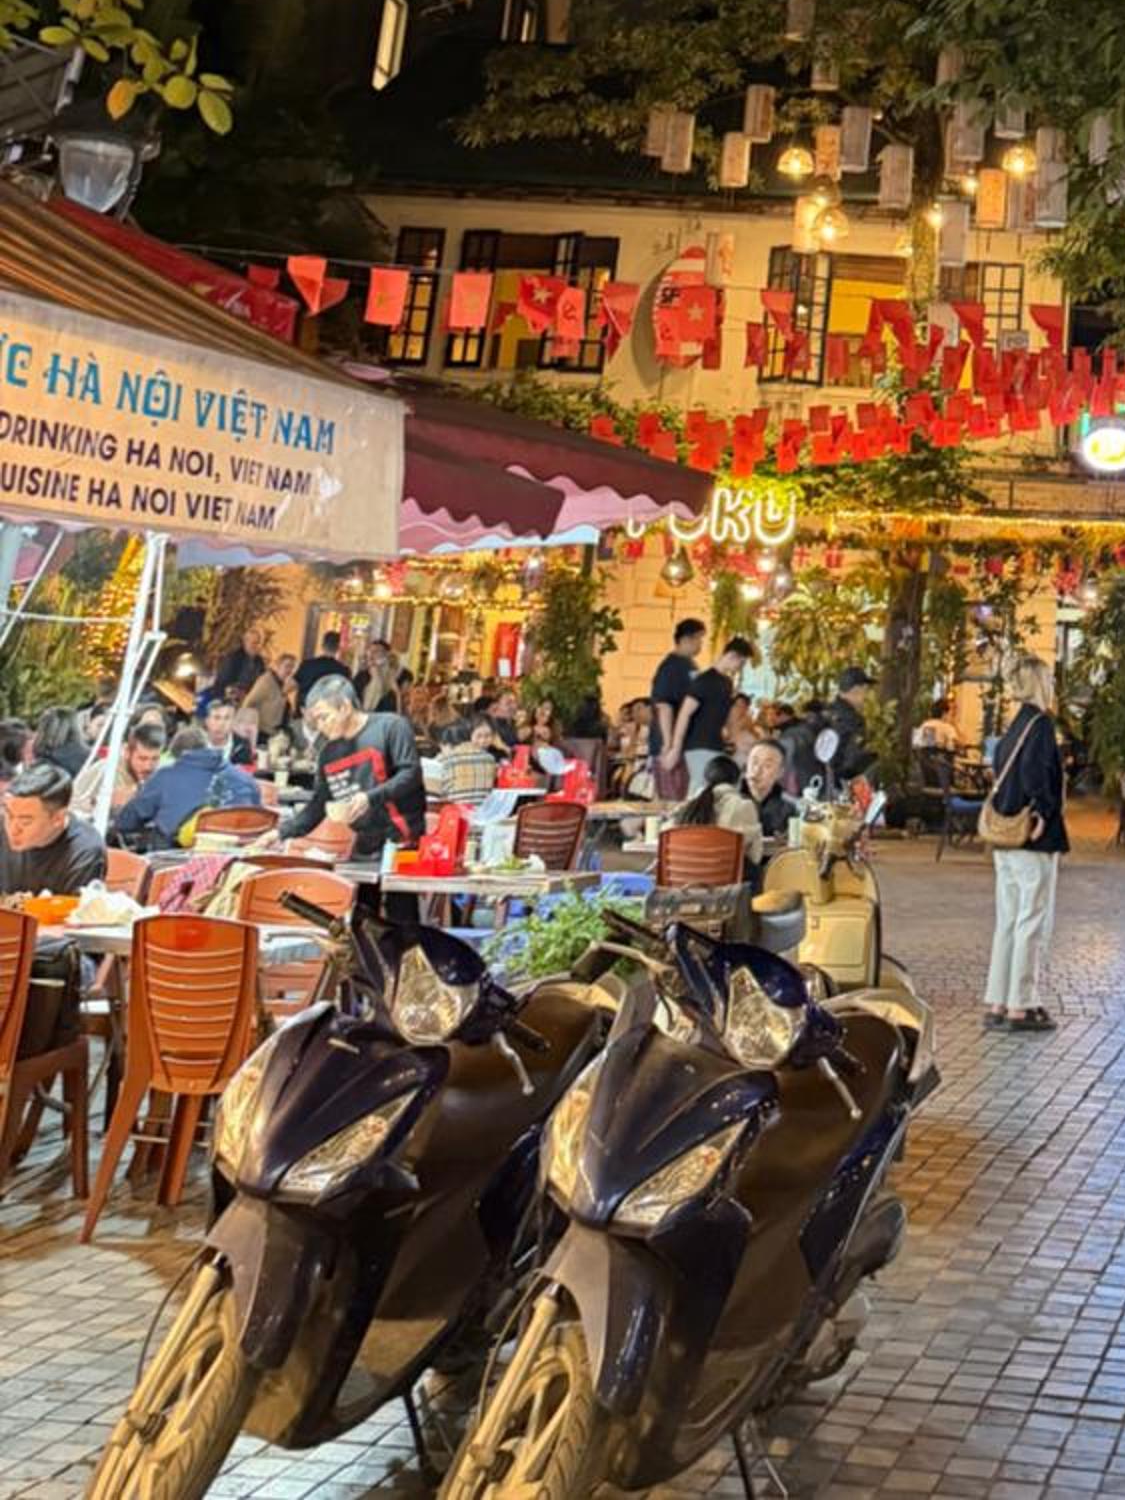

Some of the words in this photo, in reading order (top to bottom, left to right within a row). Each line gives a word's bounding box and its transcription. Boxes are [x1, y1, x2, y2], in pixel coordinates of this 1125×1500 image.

[43, 352, 102, 405] HÀ
[117, 369, 182, 427] NỘI
[195, 388, 268, 442] VIỆT
[273, 409, 336, 455] NAM
[126, 438, 162, 470] HA
[169, 450, 221, 484] NOI,
[230, 455, 264, 483] VIET
[265, 466, 312, 496] NAM
[87, 477, 122, 508] HA
[131, 485, 176, 517] NOI
[186, 493, 232, 522] VIET
[233, 501, 276, 531] NAM
